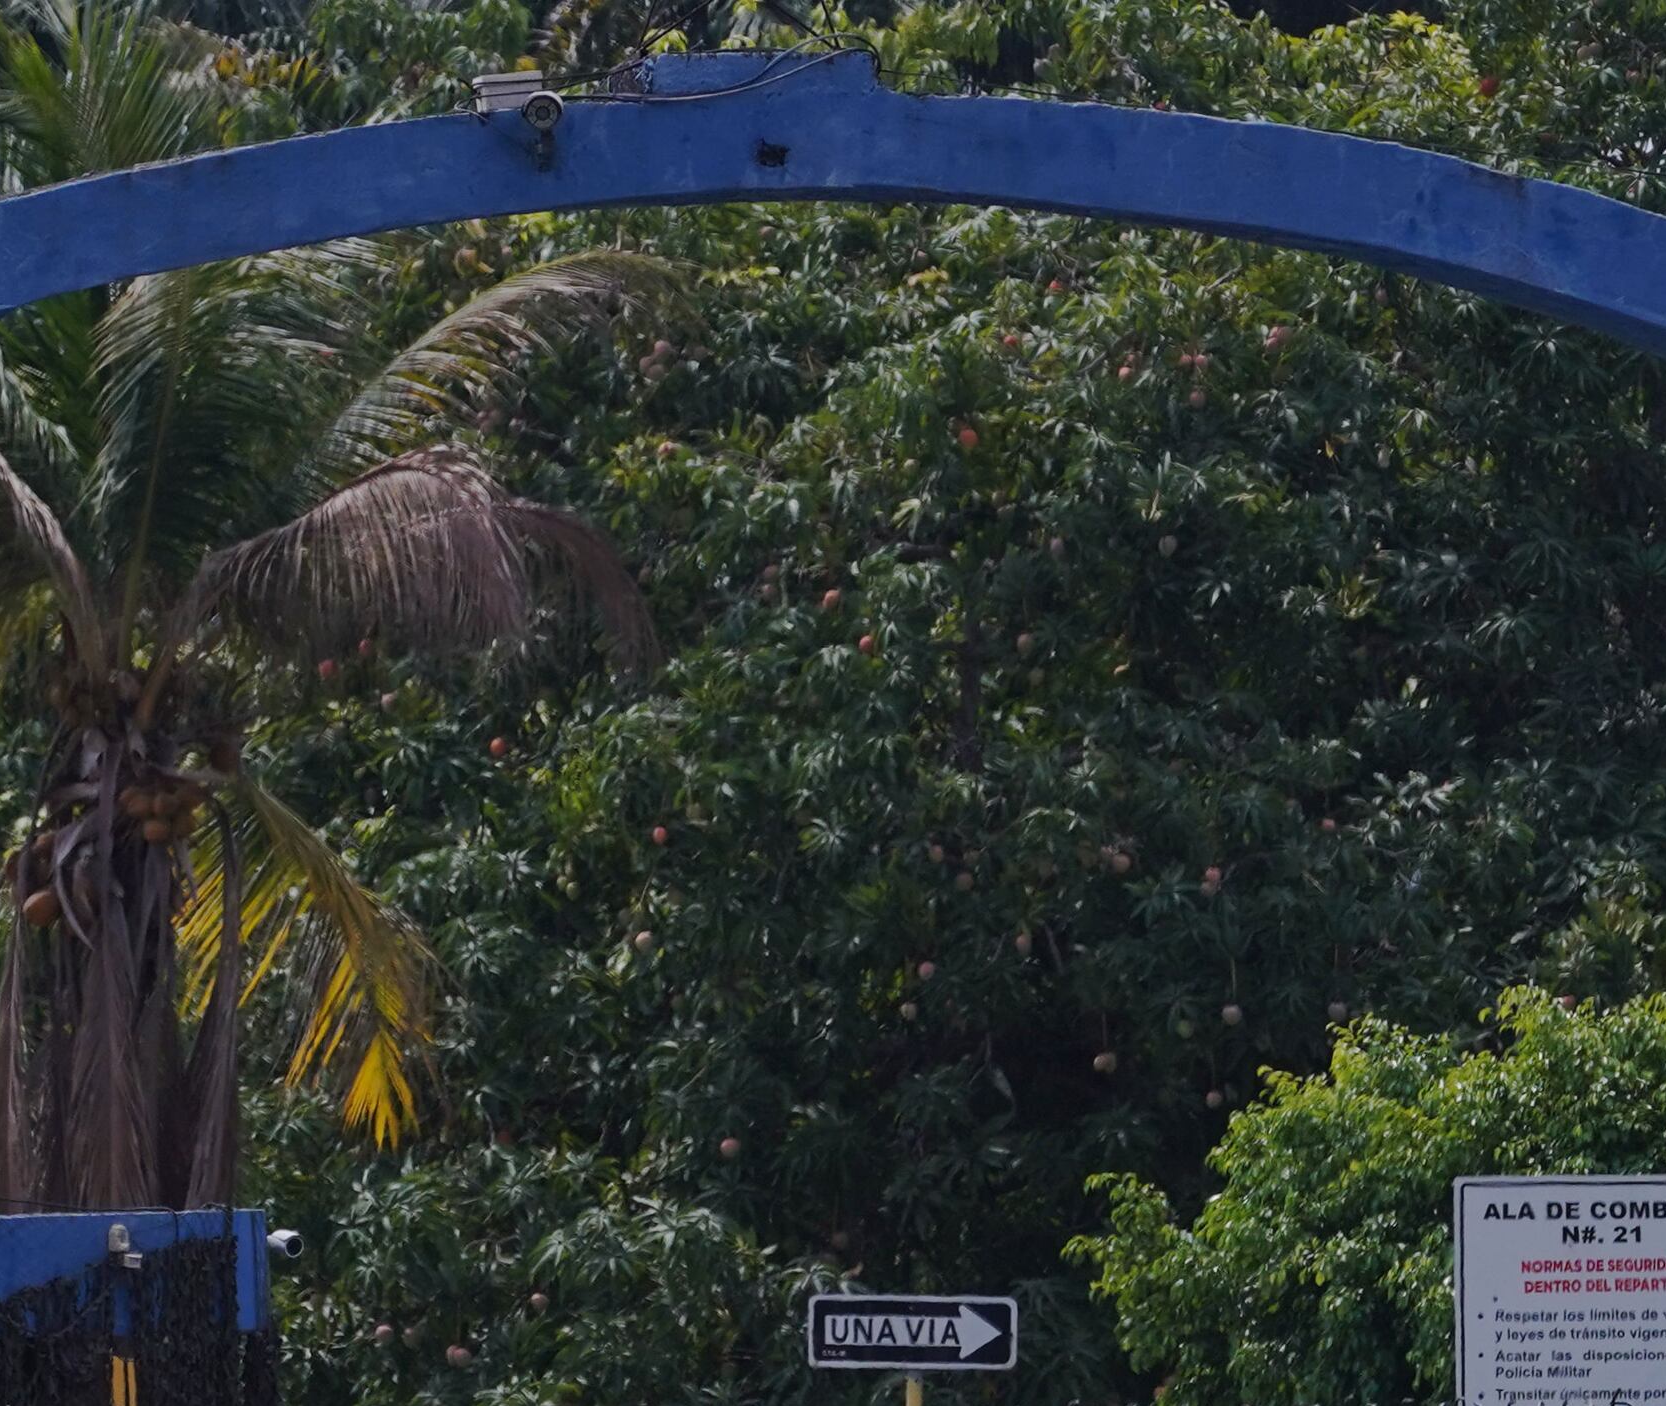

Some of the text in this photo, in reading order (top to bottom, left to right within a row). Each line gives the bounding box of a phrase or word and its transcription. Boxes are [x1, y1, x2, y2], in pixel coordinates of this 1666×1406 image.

[1484, 1202, 1535, 1220] ALA
[1547, 1201, 1580, 1220] DE
[1613, 1225, 1642, 1243] 21
[1521, 1259, 1582, 1273] NORMAS
[1586, 1259, 1604, 1272] DE
[1524, 1280, 1582, 1294] DENTRO
[1586, 1279, 1611, 1292] DEL
[1495, 1309, 1558, 1324] Respetar
[1563, 1309, 1584, 1321] los
[1641, 1308, 1658, 1320] de
[832, 1318, 960, 1346] UNA VIA
[1495, 1331, 1503, 1344] y
[1507, 1328, 1544, 1343] leyes
[1549, 1327, 1566, 1340] de
[1495, 1350, 1541, 1362] Acatar
[1551, 1350, 1572, 1361] las
[1547, 1366, 1592, 1378] Militar
[1495, 1388, 1556, 1400] Transitar
[1644, 1389, 1666, 1401] por
